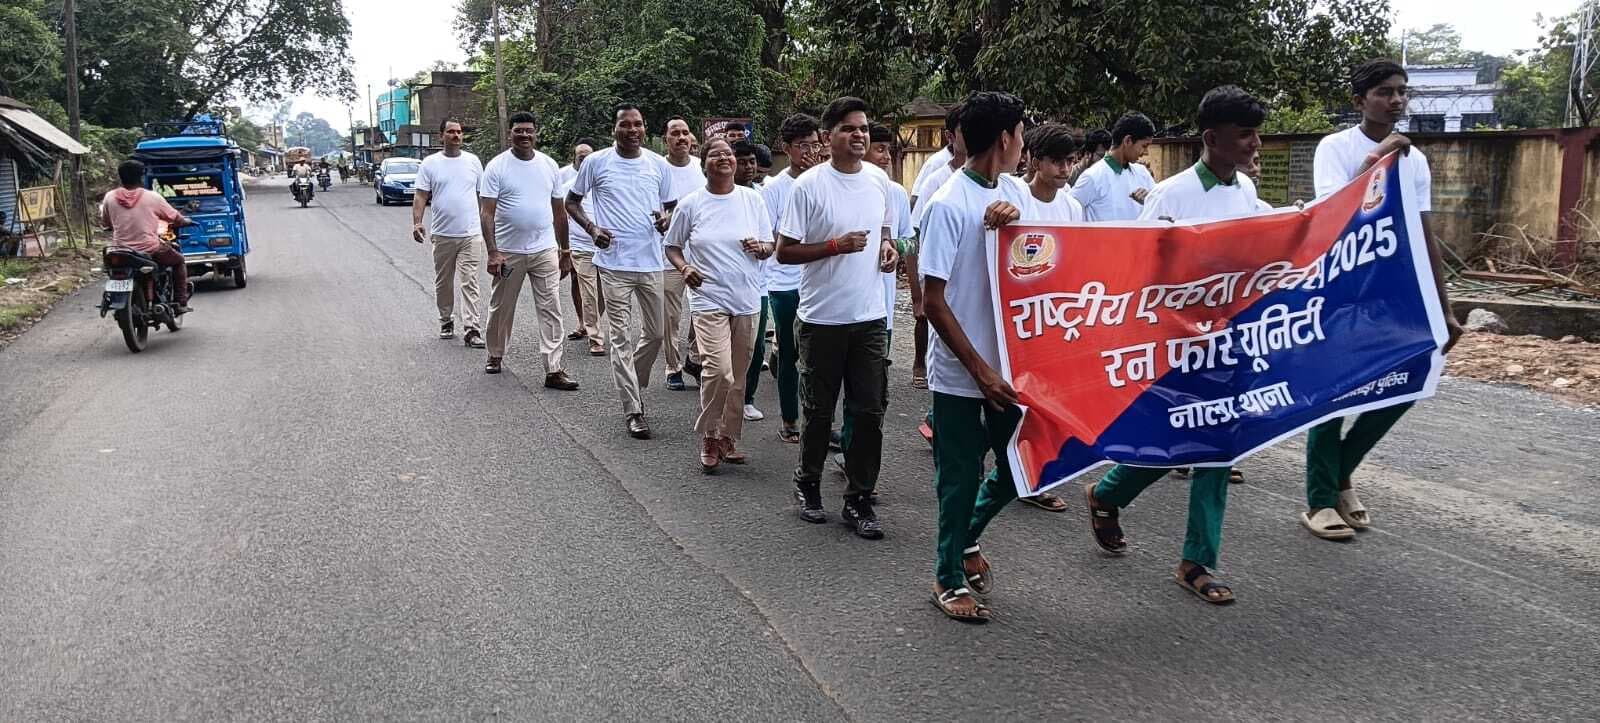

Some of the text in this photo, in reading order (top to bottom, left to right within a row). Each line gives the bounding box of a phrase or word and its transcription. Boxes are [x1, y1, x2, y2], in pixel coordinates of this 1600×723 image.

[1010, 282, 1134, 341] राष्ट्रीय
[1135, 271, 1246, 325] एकता
[1328, 216, 1397, 282] 2025
[1101, 297, 1326, 389] रन फॉर यूनिटी
[1238, 380, 1295, 414] थाना
[1375, 371, 1410, 395] पुलिस
